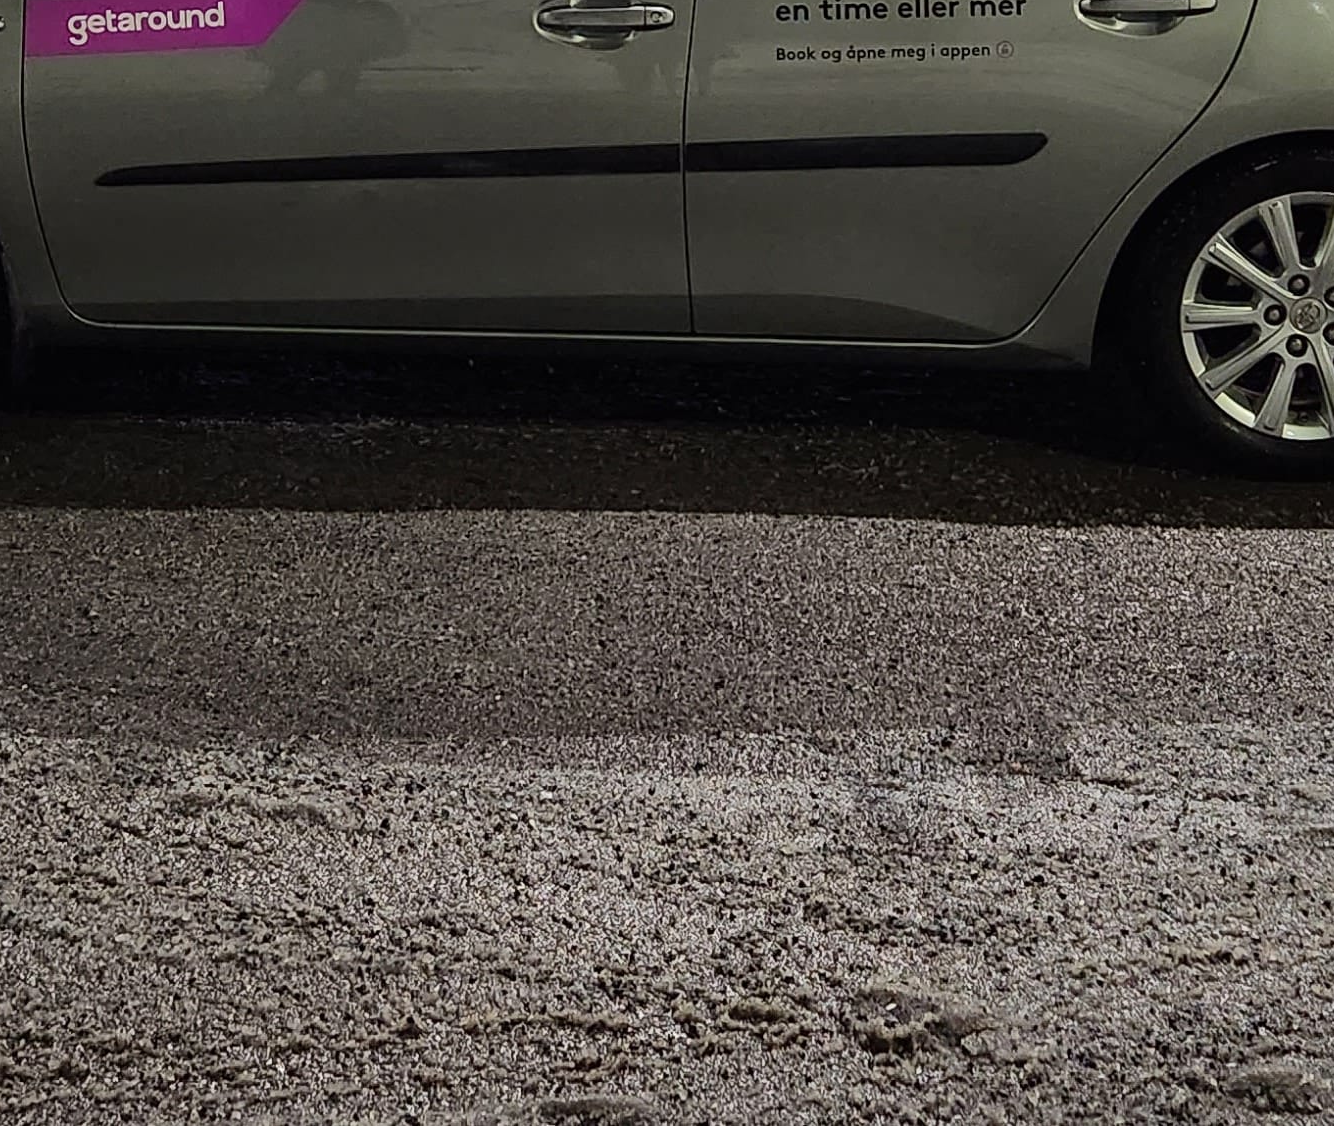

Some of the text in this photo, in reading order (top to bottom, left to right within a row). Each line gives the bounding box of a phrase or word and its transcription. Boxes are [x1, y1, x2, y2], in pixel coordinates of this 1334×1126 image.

[775, 4, 809, 22] en
[67, 1, 225, 46] getaround
[775, 46, 816, 61] Book
[820, 48, 842, 62] og
[846, 45, 887, 63] åpne
[890, 48, 926, 61] meg
[939, 44, 991, 61] appen
